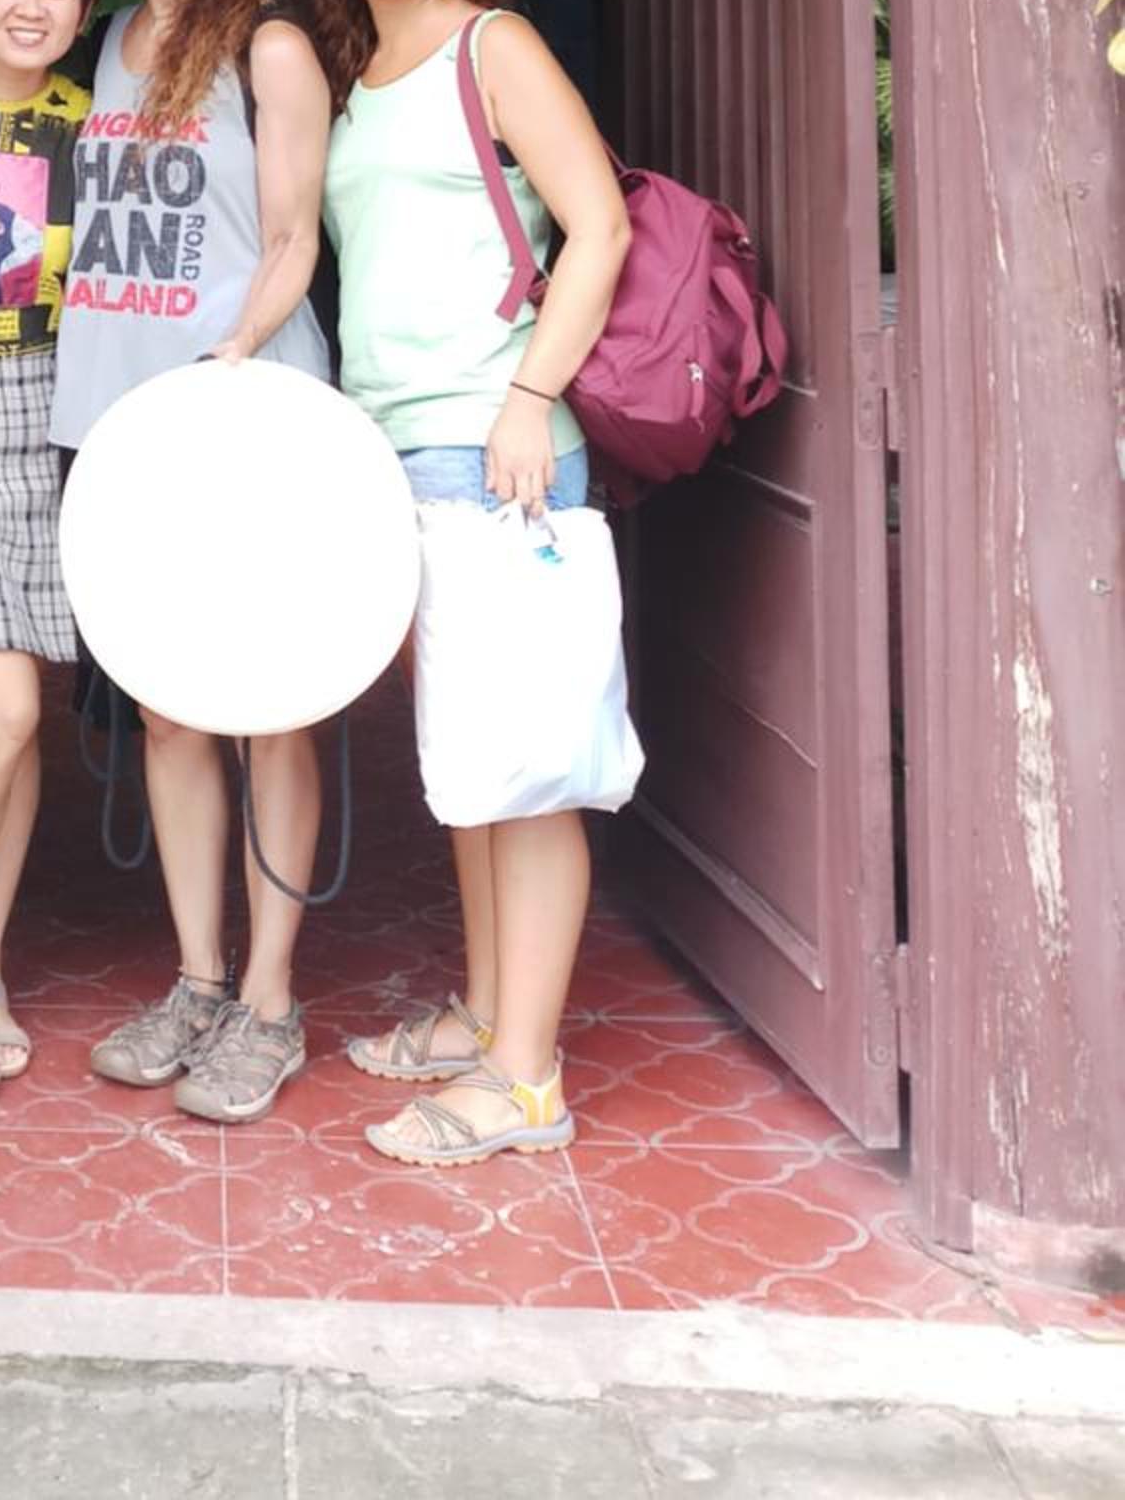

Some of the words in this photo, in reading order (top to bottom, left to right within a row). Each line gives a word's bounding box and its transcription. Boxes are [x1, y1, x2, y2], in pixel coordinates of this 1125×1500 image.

[74, 141, 207, 209] HAO
[72, 207, 182, 280] AN
[180, 213, 206, 281] ROAD
